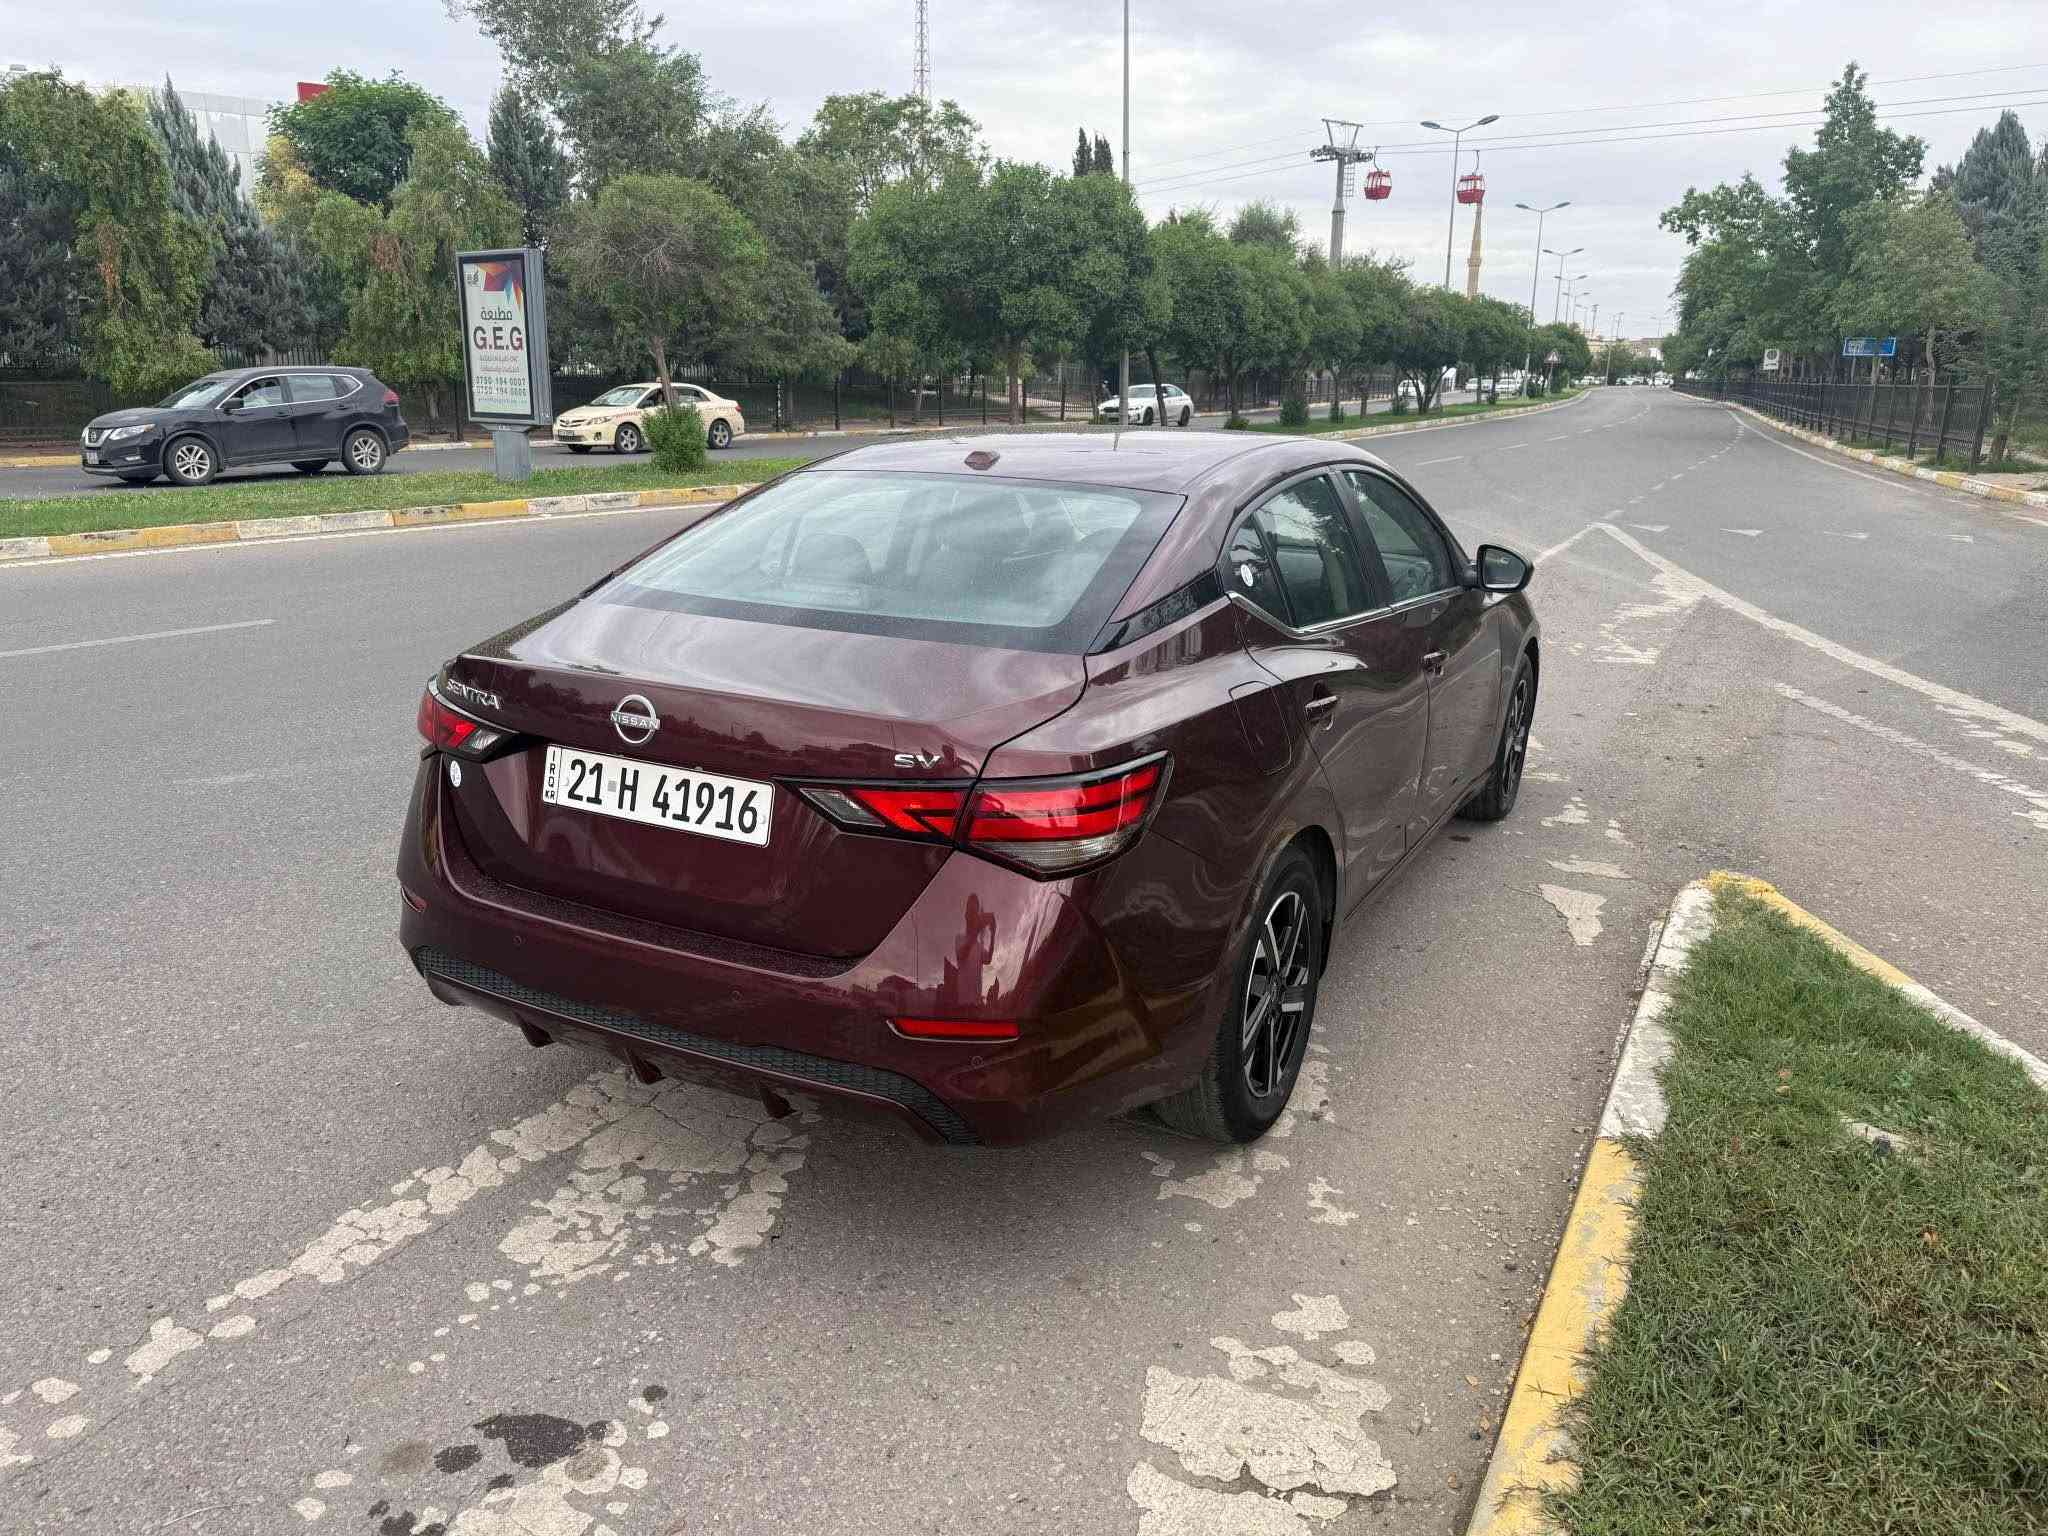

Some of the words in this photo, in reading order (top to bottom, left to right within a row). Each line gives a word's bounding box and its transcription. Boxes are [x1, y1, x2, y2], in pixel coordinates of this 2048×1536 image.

[480, 304, 513, 324] مطبعة
[473, 326, 523, 351] G.E.G
[446, 678, 502, 711] SENTRA
[610, 711, 661, 730] NISSAN
[548, 749, 556, 788] IRQ
[894, 753, 943, 769] SV
[568, 758, 603, 805] 21
[617, 767, 640, 812] H
[652, 774, 758, 834] 41916
